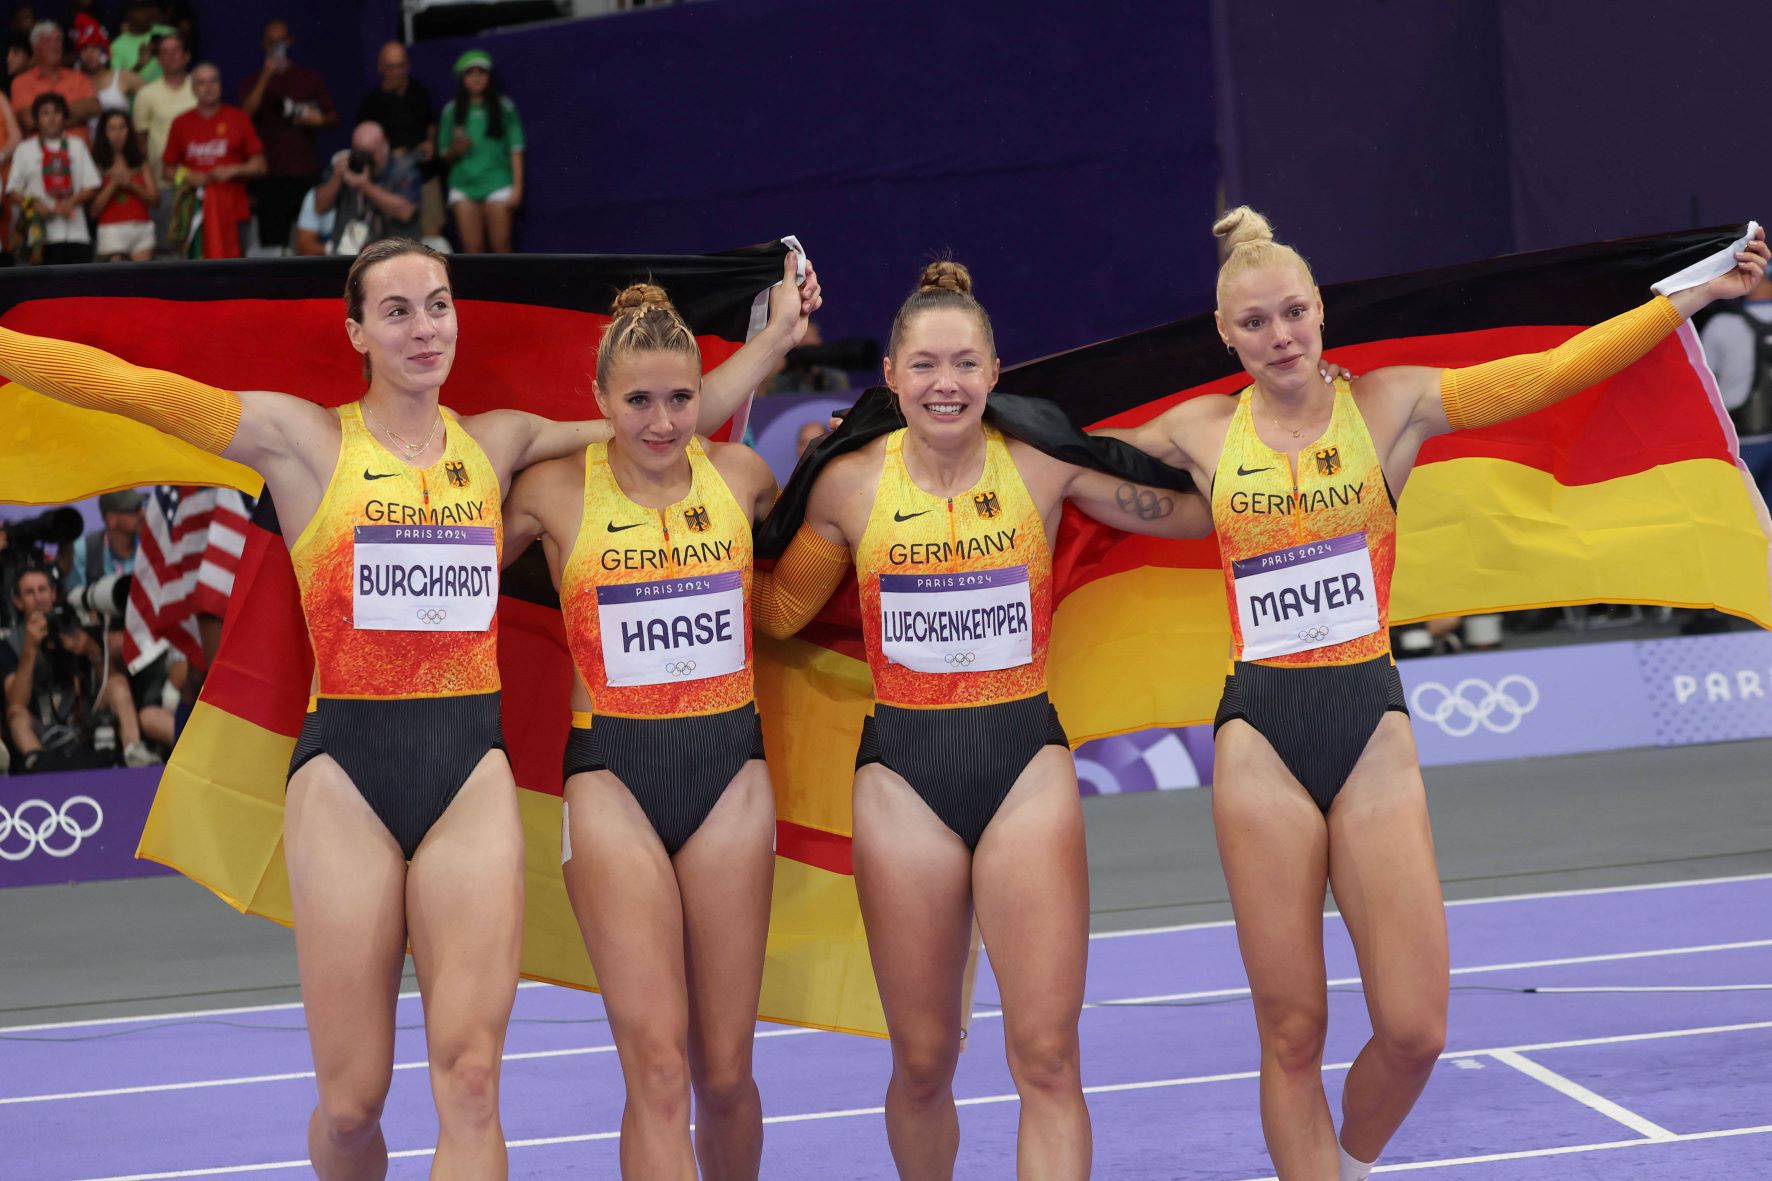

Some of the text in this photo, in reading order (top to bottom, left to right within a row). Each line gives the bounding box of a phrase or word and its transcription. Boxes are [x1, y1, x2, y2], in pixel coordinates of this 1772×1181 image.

[365, 500, 483, 526] GERMANY
[1231, 482, 1364, 515] GERMANY
[395, 529, 468, 540] PARIS 2024
[889, 528, 1016, 565] GERMANY
[602, 540, 732, 571] GERMANY
[1261, 543, 1333, 568] PARIS 2024
[360, 564, 492, 597] BURGHARDT
[635, 580, 711, 597] PARIS 2024
[917, 574, 992, 589] PARIS 2024
[1250, 572, 1364, 626] MAYER
[621, 609, 732, 653] HAASE
[884, 601, 1027, 642] LUECKENKEMPER
[1673, 668, 1772, 704] PAR
